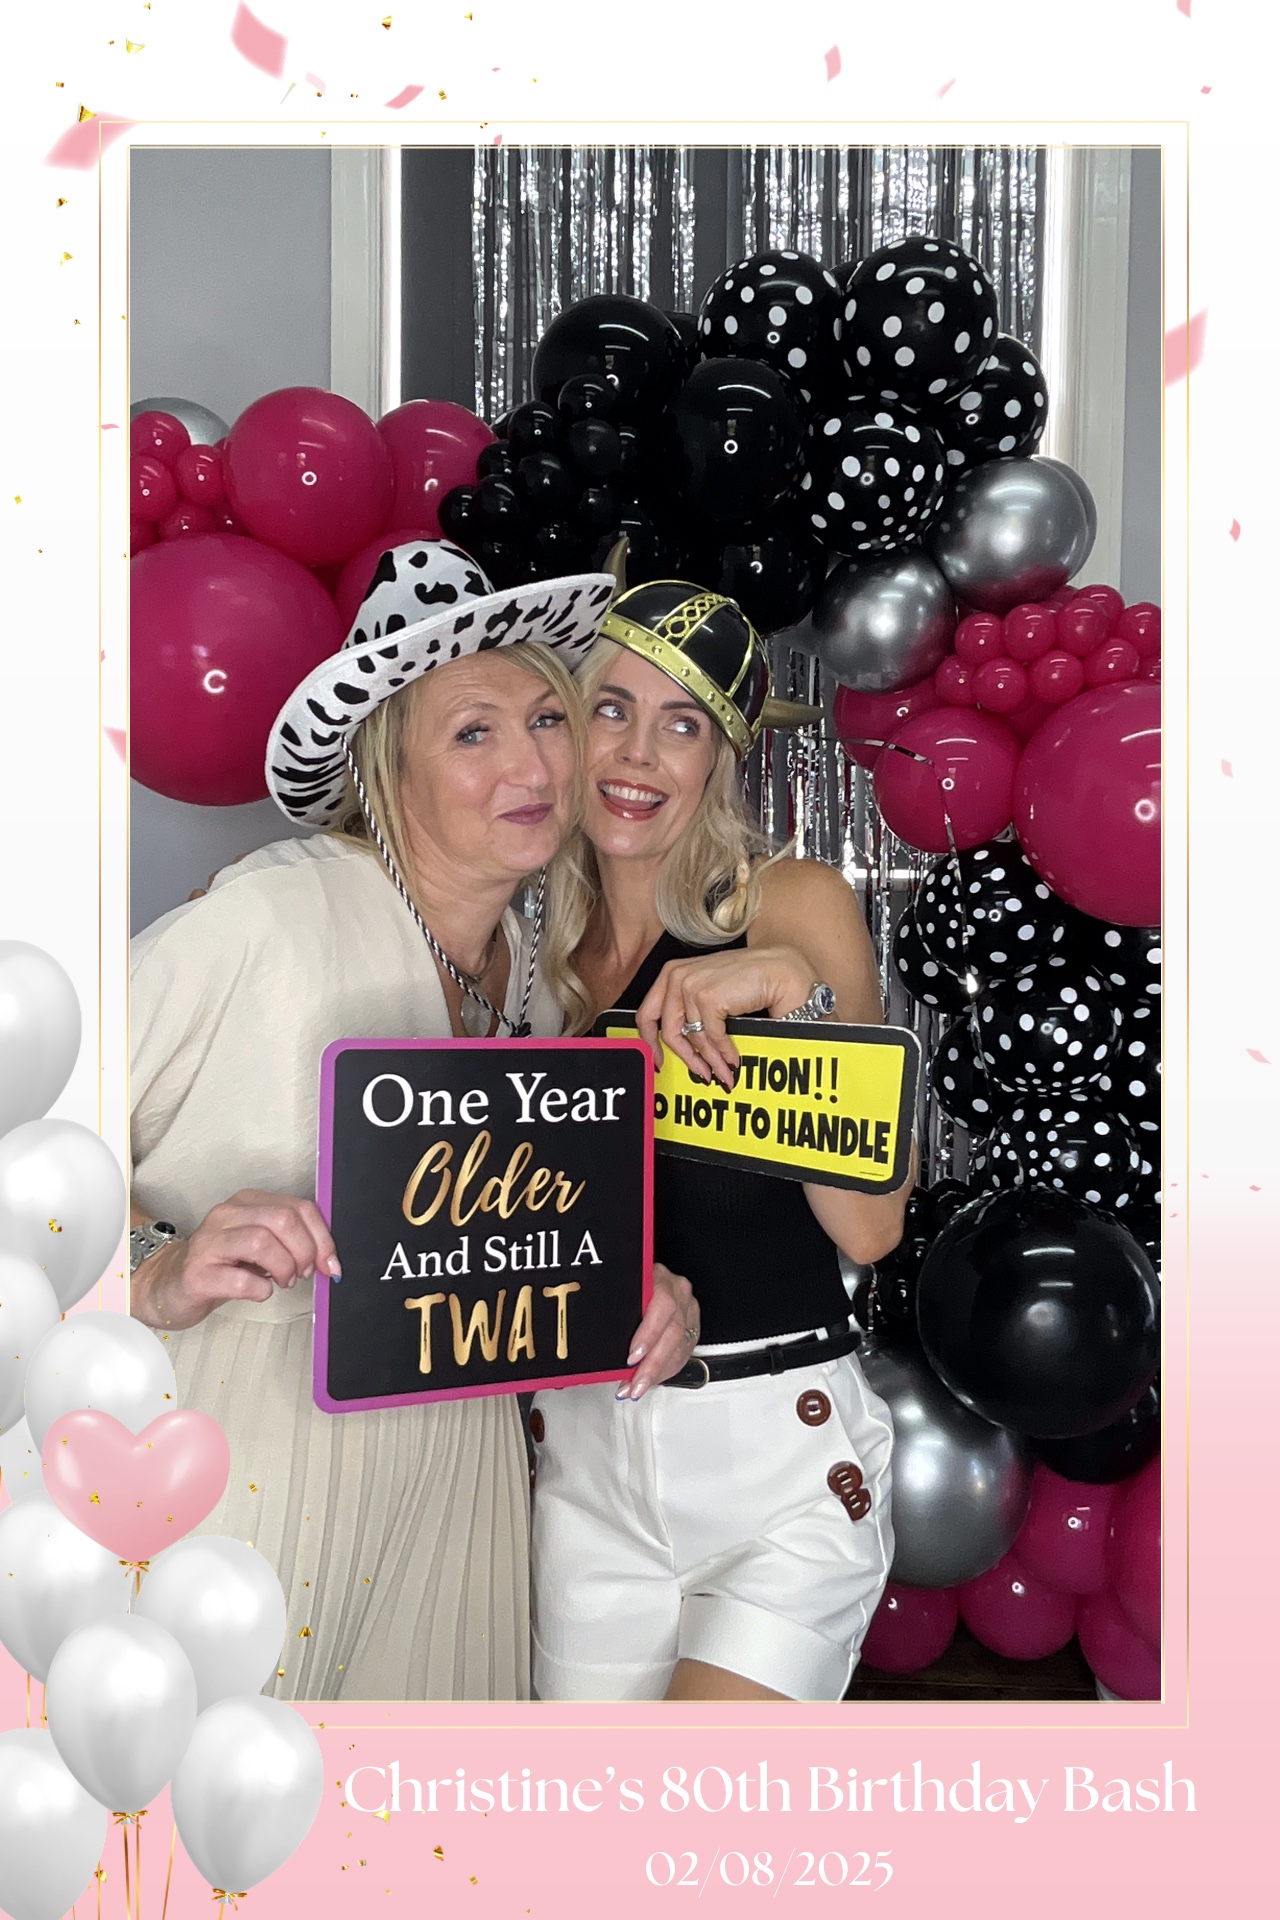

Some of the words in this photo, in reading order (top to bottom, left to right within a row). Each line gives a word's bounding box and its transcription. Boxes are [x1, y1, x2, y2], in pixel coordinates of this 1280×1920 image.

[362, 1073, 489, 1128] One
[505, 1072, 627, 1123] Year
[674, 1094, 729, 1131] HOT
[735, 1101, 771, 1139] TO
[777, 1108, 891, 1164] HANDLE
[402, 1130, 585, 1227] Older
[380, 1236, 471, 1280] And
[483, 1230, 561, 1272] Still
[570, 1230, 603, 1266] A
[404, 1281, 581, 1375] TWAT
